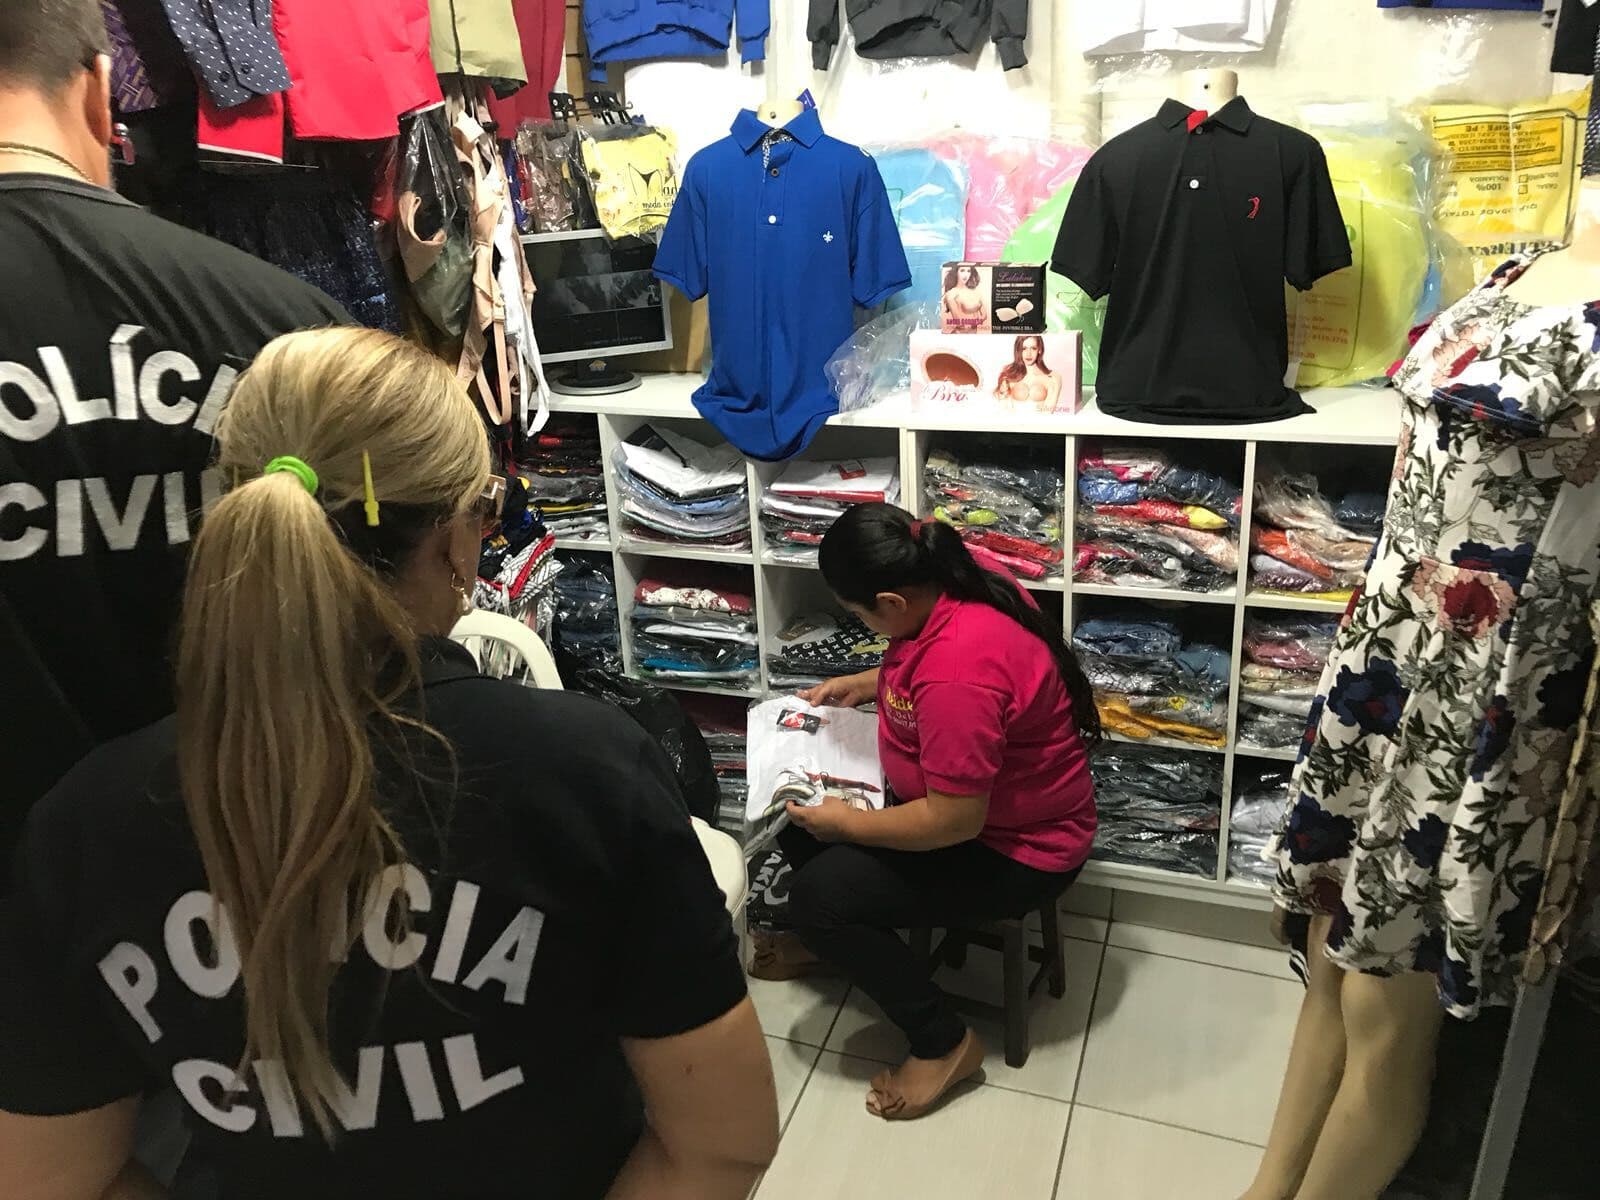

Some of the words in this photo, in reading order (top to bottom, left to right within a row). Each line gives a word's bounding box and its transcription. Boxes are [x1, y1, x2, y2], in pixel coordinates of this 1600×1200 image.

[1475, 183, 1502, 191] 100%
[97, 863, 545, 1043] POCIA
[172, 1033, 525, 1137] CIVIL
